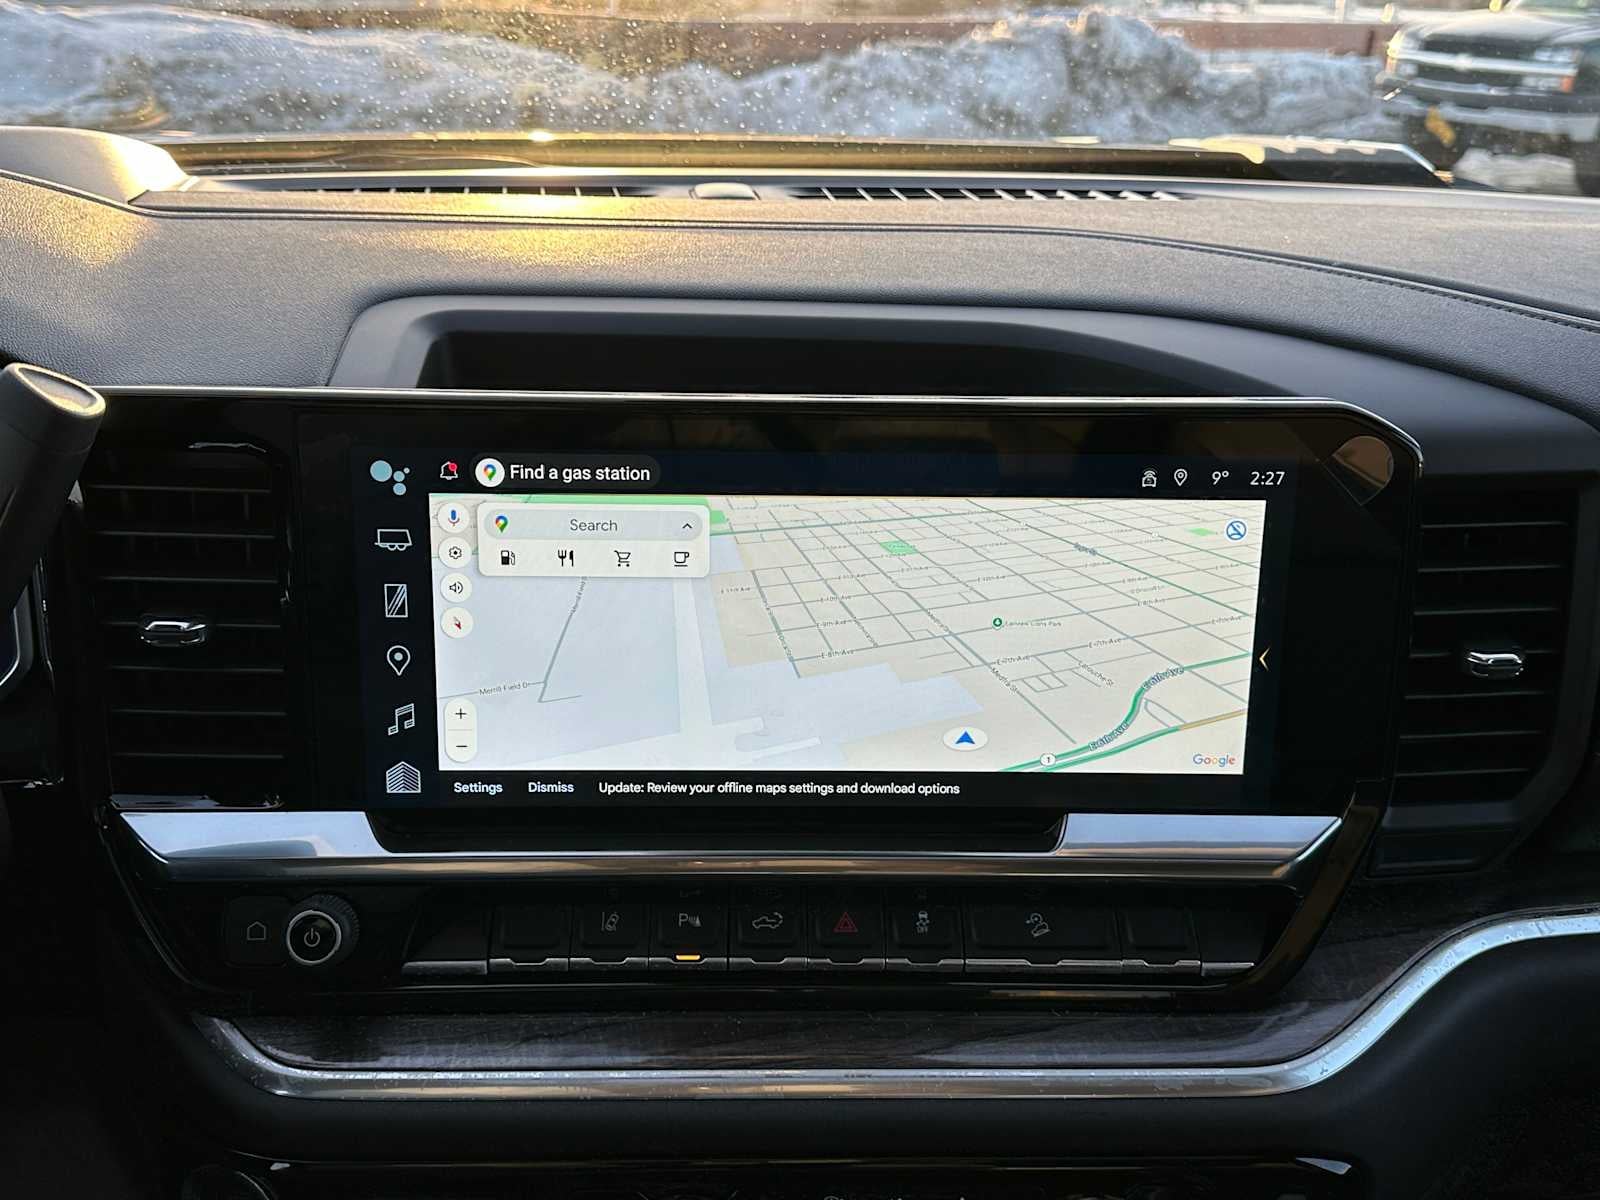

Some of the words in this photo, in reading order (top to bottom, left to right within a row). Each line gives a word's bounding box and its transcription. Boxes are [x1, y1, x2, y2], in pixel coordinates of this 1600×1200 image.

[510, 464, 545, 480] Find
[549, 468, 559, 480] a
[562, 467, 592, 483] gas
[595, 466, 651, 481] station
[1250, 470, 1286, 486] 2:27
[569, 518, 618, 532] Search
[1192, 753, 1236, 768] Google
[453, 781, 503, 796] Settings
[527, 781, 575, 794] Dismiss
[598, 782, 645, 796] Update:
[647, 782, 687, 794] Review
[689, 784, 715, 797] your
[717, 781, 753, 794] offline
[755, 785, 787, 796] maps
[788, 782, 834, 797] settings
[836, 782, 858, 795] and
[860, 783, 916, 795] download
[917, 783, 961, 797] options
